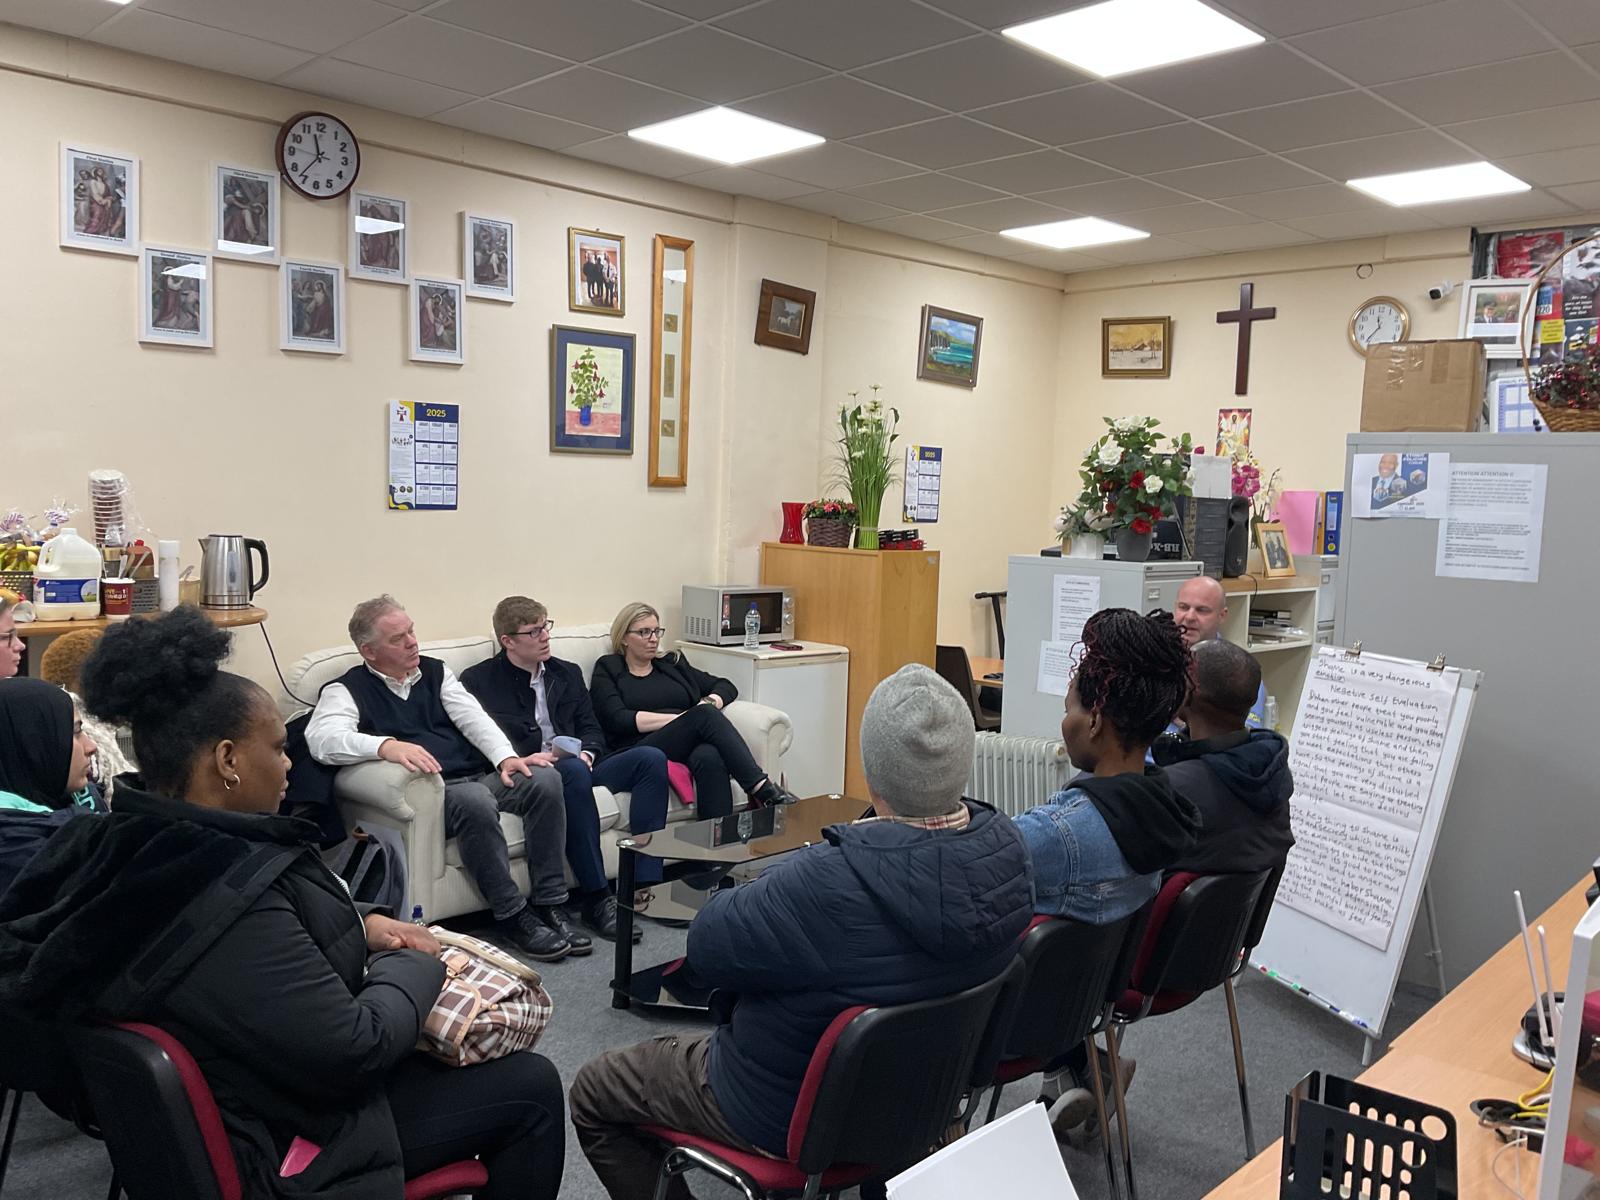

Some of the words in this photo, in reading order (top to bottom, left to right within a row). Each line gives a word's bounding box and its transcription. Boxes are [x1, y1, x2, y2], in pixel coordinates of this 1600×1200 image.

[302, 124, 311, 134] 11
[316, 122, 326, 133] 12
[292, 134, 302, 144] 10
[334, 131, 338, 140] 1
[288, 146, 295, 156] 9
[340, 142, 347, 152] 2
[341, 157, 348, 166] 3
[291, 162, 298, 172] 8
[302, 174, 308, 184] 7
[336, 171, 343, 179] 4
[313, 181, 320, 190] 6
[326, 179, 333, 188] 5
[426, 409, 447, 418] 2025
